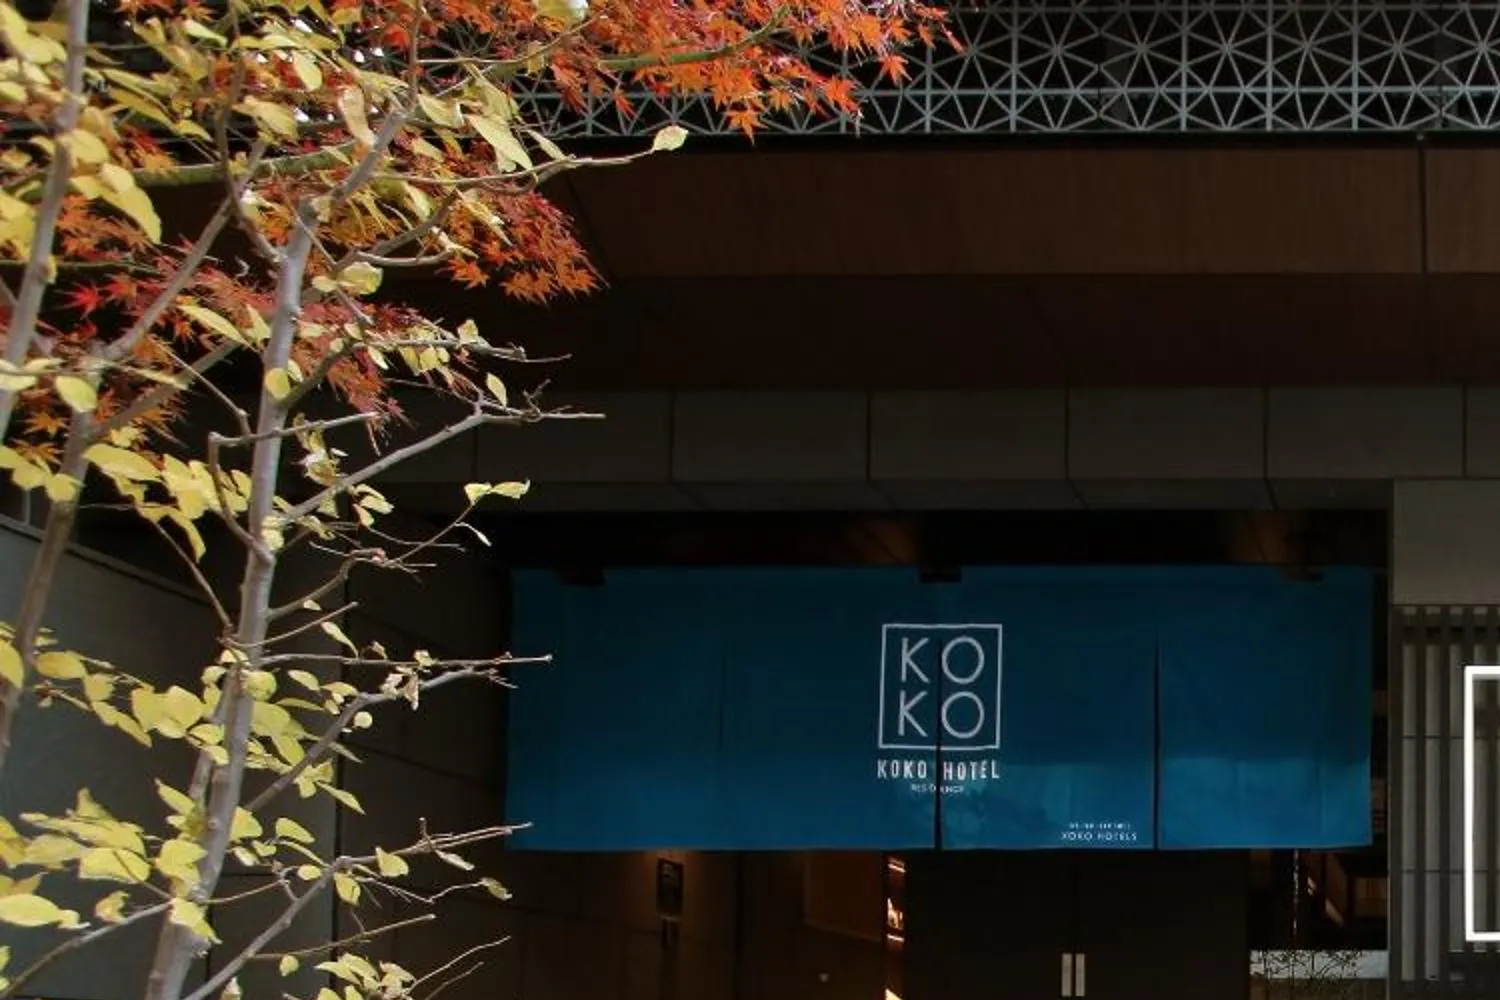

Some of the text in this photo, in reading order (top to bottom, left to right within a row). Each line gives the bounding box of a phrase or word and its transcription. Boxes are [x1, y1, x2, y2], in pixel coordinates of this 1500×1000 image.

[901, 636, 985, 684] KO
[898, 690, 985, 738] KO
[877, 759, 1000, 781] KOKO HOTEL
